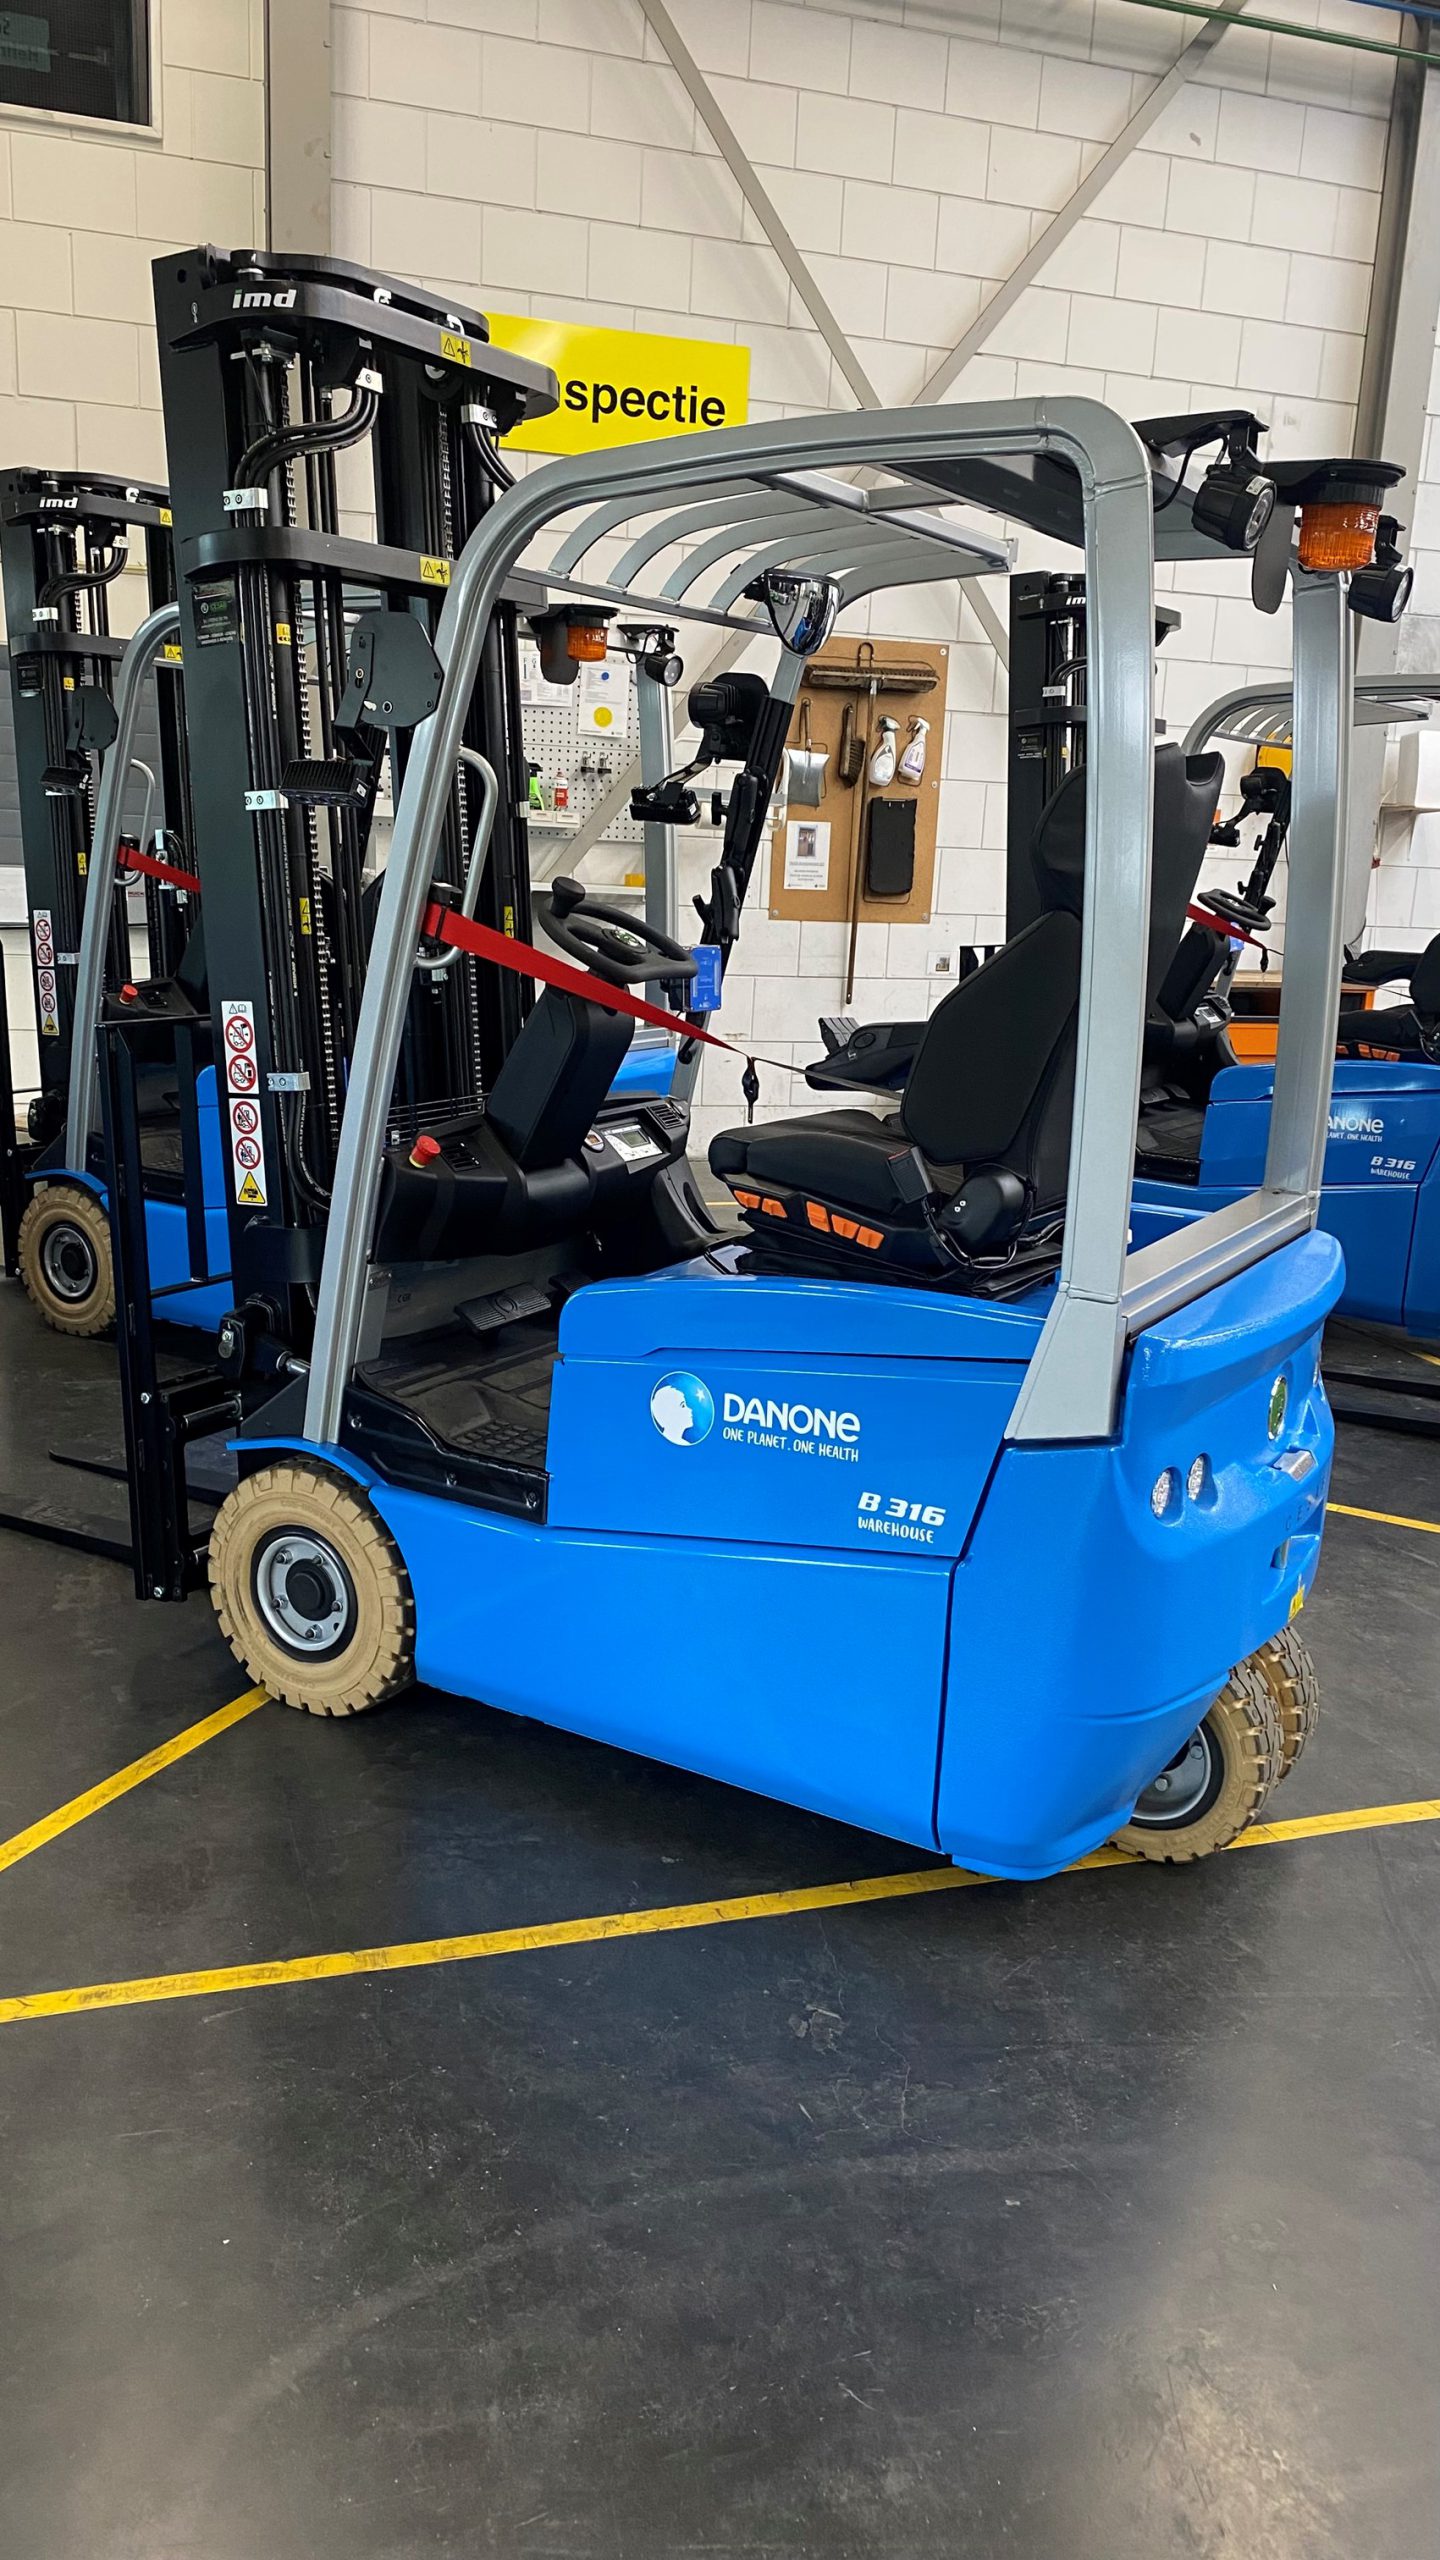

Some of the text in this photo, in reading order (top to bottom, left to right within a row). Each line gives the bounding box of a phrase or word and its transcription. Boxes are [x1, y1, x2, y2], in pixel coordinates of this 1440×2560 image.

[232, 289, 297, 309] imd
[558, 380, 726, 427] spectie
[39, 496, 79, 509] imd
[1066, 596, 1087, 606] im
[1370, 1155, 1417, 1171] B 316
[1370, 1167, 1411, 1180] WAREHOUSE
[722, 1427, 745, 1442] ONE
[792, 1439, 816, 1455] ONE
[818, 1442, 860, 1463] HEALTH
[857, 1491, 947, 1527] B 316
[857, 1516, 935, 1544] WAREHOUSE
